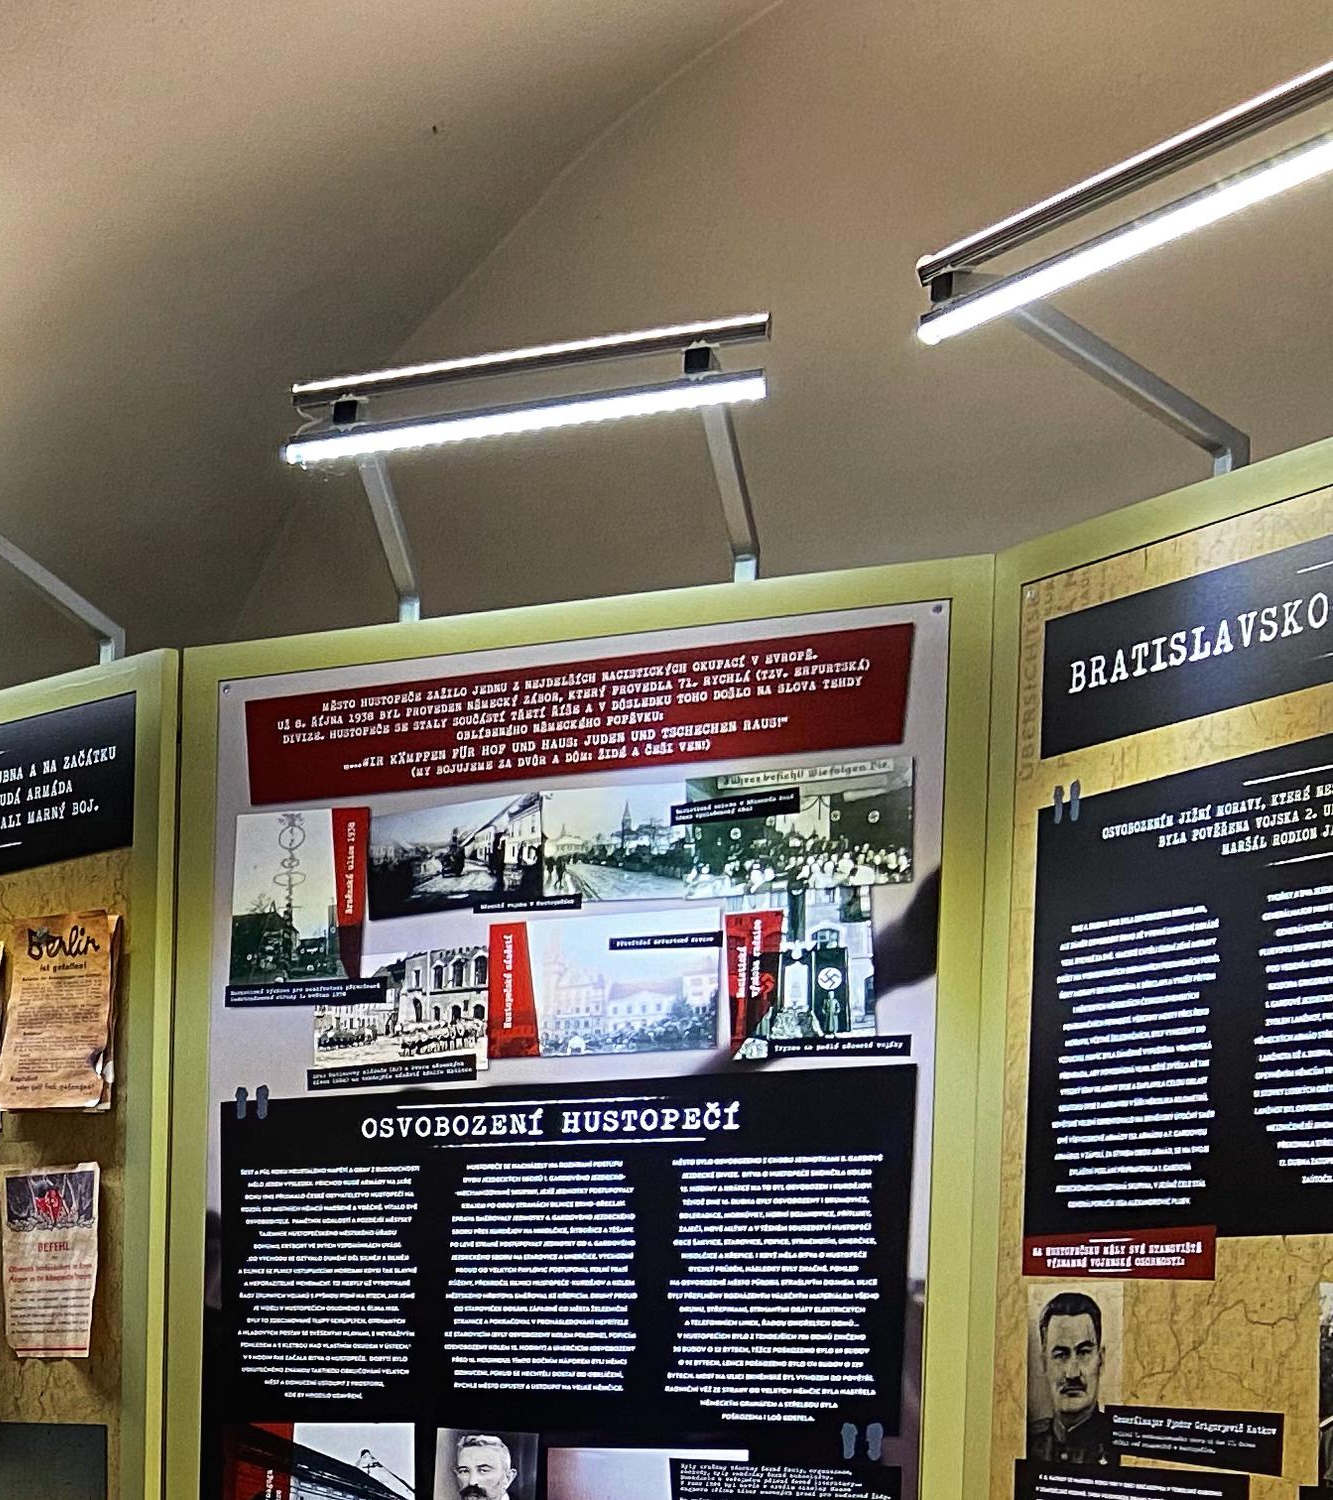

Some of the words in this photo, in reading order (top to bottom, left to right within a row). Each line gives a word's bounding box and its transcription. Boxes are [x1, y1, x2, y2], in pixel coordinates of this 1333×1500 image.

[349, 711, 374, 722] 1938
[379, 709, 401, 719] BYL
[405, 702, 461, 716] PROVEDEN
[467, 694, 518, 710] NĚMECKÝ
[569, 685, 605, 699] KTERÝ
[612, 680, 672, 695] PROVEDLA
[703, 670, 750, 685] RYCHLÁ
[795, 658, 870, 676] ERFURTSKÁ)
[361, 691, 421, 708] HUSTOPEČE
[426, 688, 467, 701] ZAŽILO
[472, 684, 507, 696] JEDNU
[513, 682, 520, 691] Z
[603, 663, 686, 681] NACISTICKÝCH
[693, 655, 745, 671] OKUPACÍ
[751, 656, 759, 665] V
[283, 731, 325, 743] DIVIZE.
[330, 722, 389, 738] HUSTOPEČE
[395, 722, 409, 732] SE
[413, 718, 447, 730] STALY
[453, 710, 505, 726] SOUČÁSTÍ
[511, 706, 545, 720] TŘETÍ
[585, 703, 593, 712] A
[599, 702, 606, 711] V
[611, 695, 671, 710] DŮSLEDKU
[677, 692, 708, 703] TOHO
[713, 686, 751, 699] DOŠLO
[757, 685, 771, 695] NA
[777, 680, 817, 693] SLOVA
[823, 676, 863, 688] TEHDY
[452, 745, 475, 758] FÜR
[481, 744, 506, 755] HOF
[512, 741, 535, 752] UND
[584, 732, 625, 746] JUDEN
[631, 730, 655, 741] UND
[661, 722, 737, 738] TSCHECHEN
[29, 766, 37, 777] A
[43, 762, 57, 774] NA
[63, 746, 117, 769] ZAČÁTKU
[436, 761, 493, 775] BOJUJEME
[499, 759, 511, 769] ZA
[551, 755, 559, 764] A
[632, 747, 639, 756] A
[27, 780, 73, 801] ARMÁDA
[27, 805, 66, 825] MARNÝ
[72, 800, 99, 815] BOJ.
[1103, 814, 1173, 840] OSVOBOZENÍM
[1179, 804, 1211, 824] JIŽNÍ
[1216, 796, 1266, 818] MORAVY,
[1271, 785, 1311, 806] KTERÉ
[1158, 832, 1187, 848] BYLA
[1191, 819, 1249, 842] POVĚŘENA
[1255, 811, 1299, 831] VOJSKA
[1305, 808, 1317, 820] 2.
[1323, 804, 1333, 816] U
[1221, 834, 1267, 856] MARŠÁL
[1272, 827, 1317, 846] RODION
[27, 925, 101, 960] Berlin
[361, 1108, 543, 1138] OSVOBOZENÍ
[561, 1102, 741, 1134] HUSTOPEČÍ
[1091, 1256, 1131, 1267] VOJENSKÉ
[1103, 1244, 1125, 1255] MĚLY
